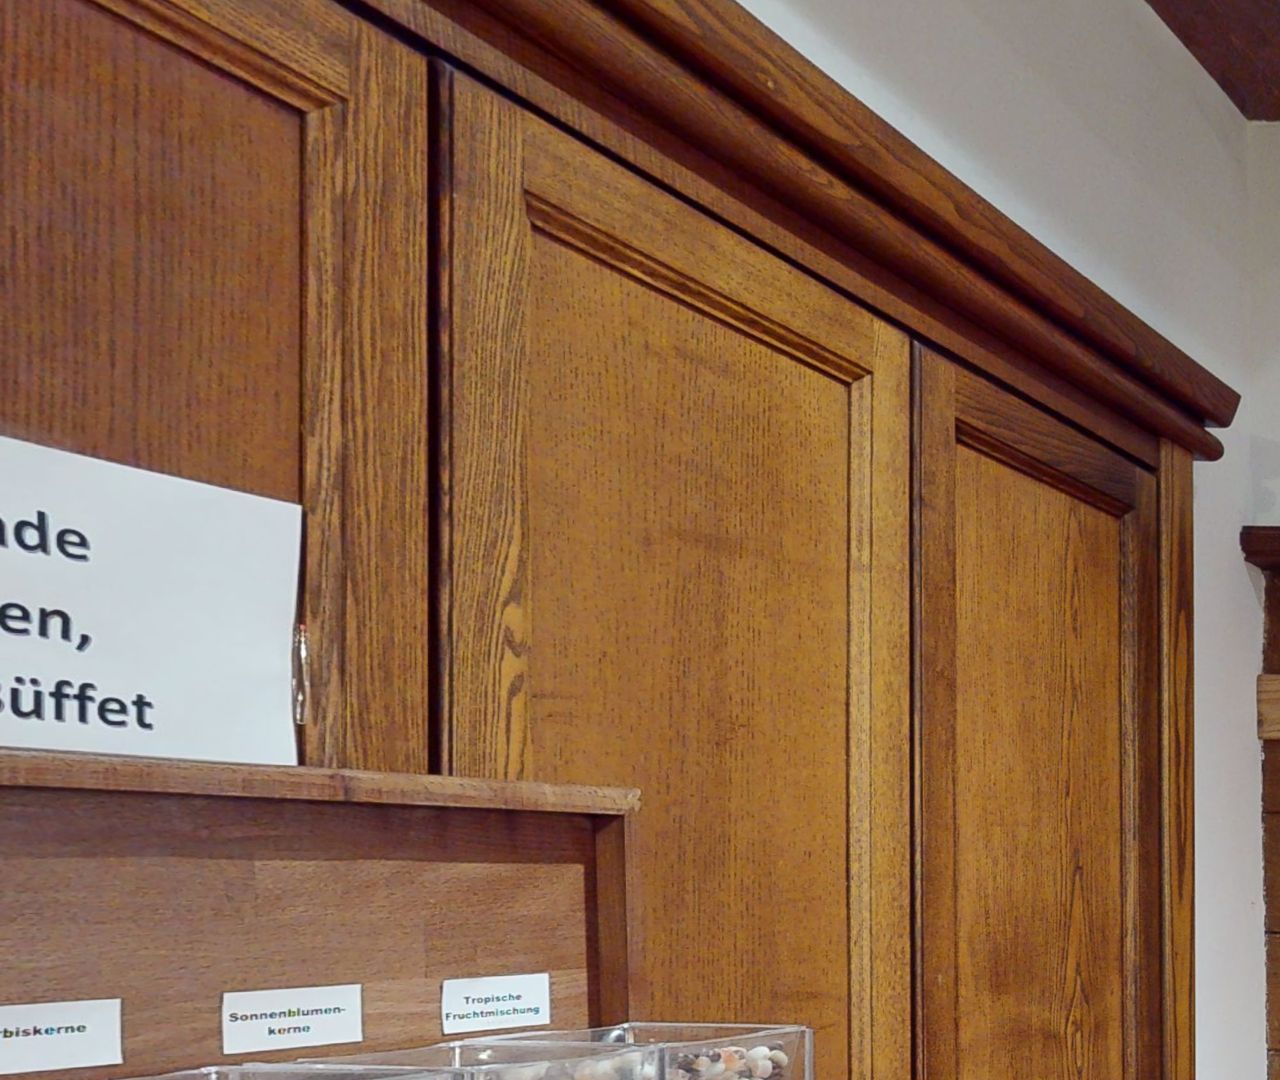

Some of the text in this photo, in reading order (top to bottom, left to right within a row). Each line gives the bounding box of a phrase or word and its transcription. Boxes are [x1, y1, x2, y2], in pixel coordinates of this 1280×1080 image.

[0, 510, 90, 562] de
[0, 675, 154, 731] üffet
[463, 993, 522, 1005] Tropische
[228, 1005, 346, 1023] Sonnenblumen-
[445, 1005, 540, 1021] Fruchtmischung
[0, 1025, 87, 1039] biskerne
[268, 1024, 311, 1037] kerne
